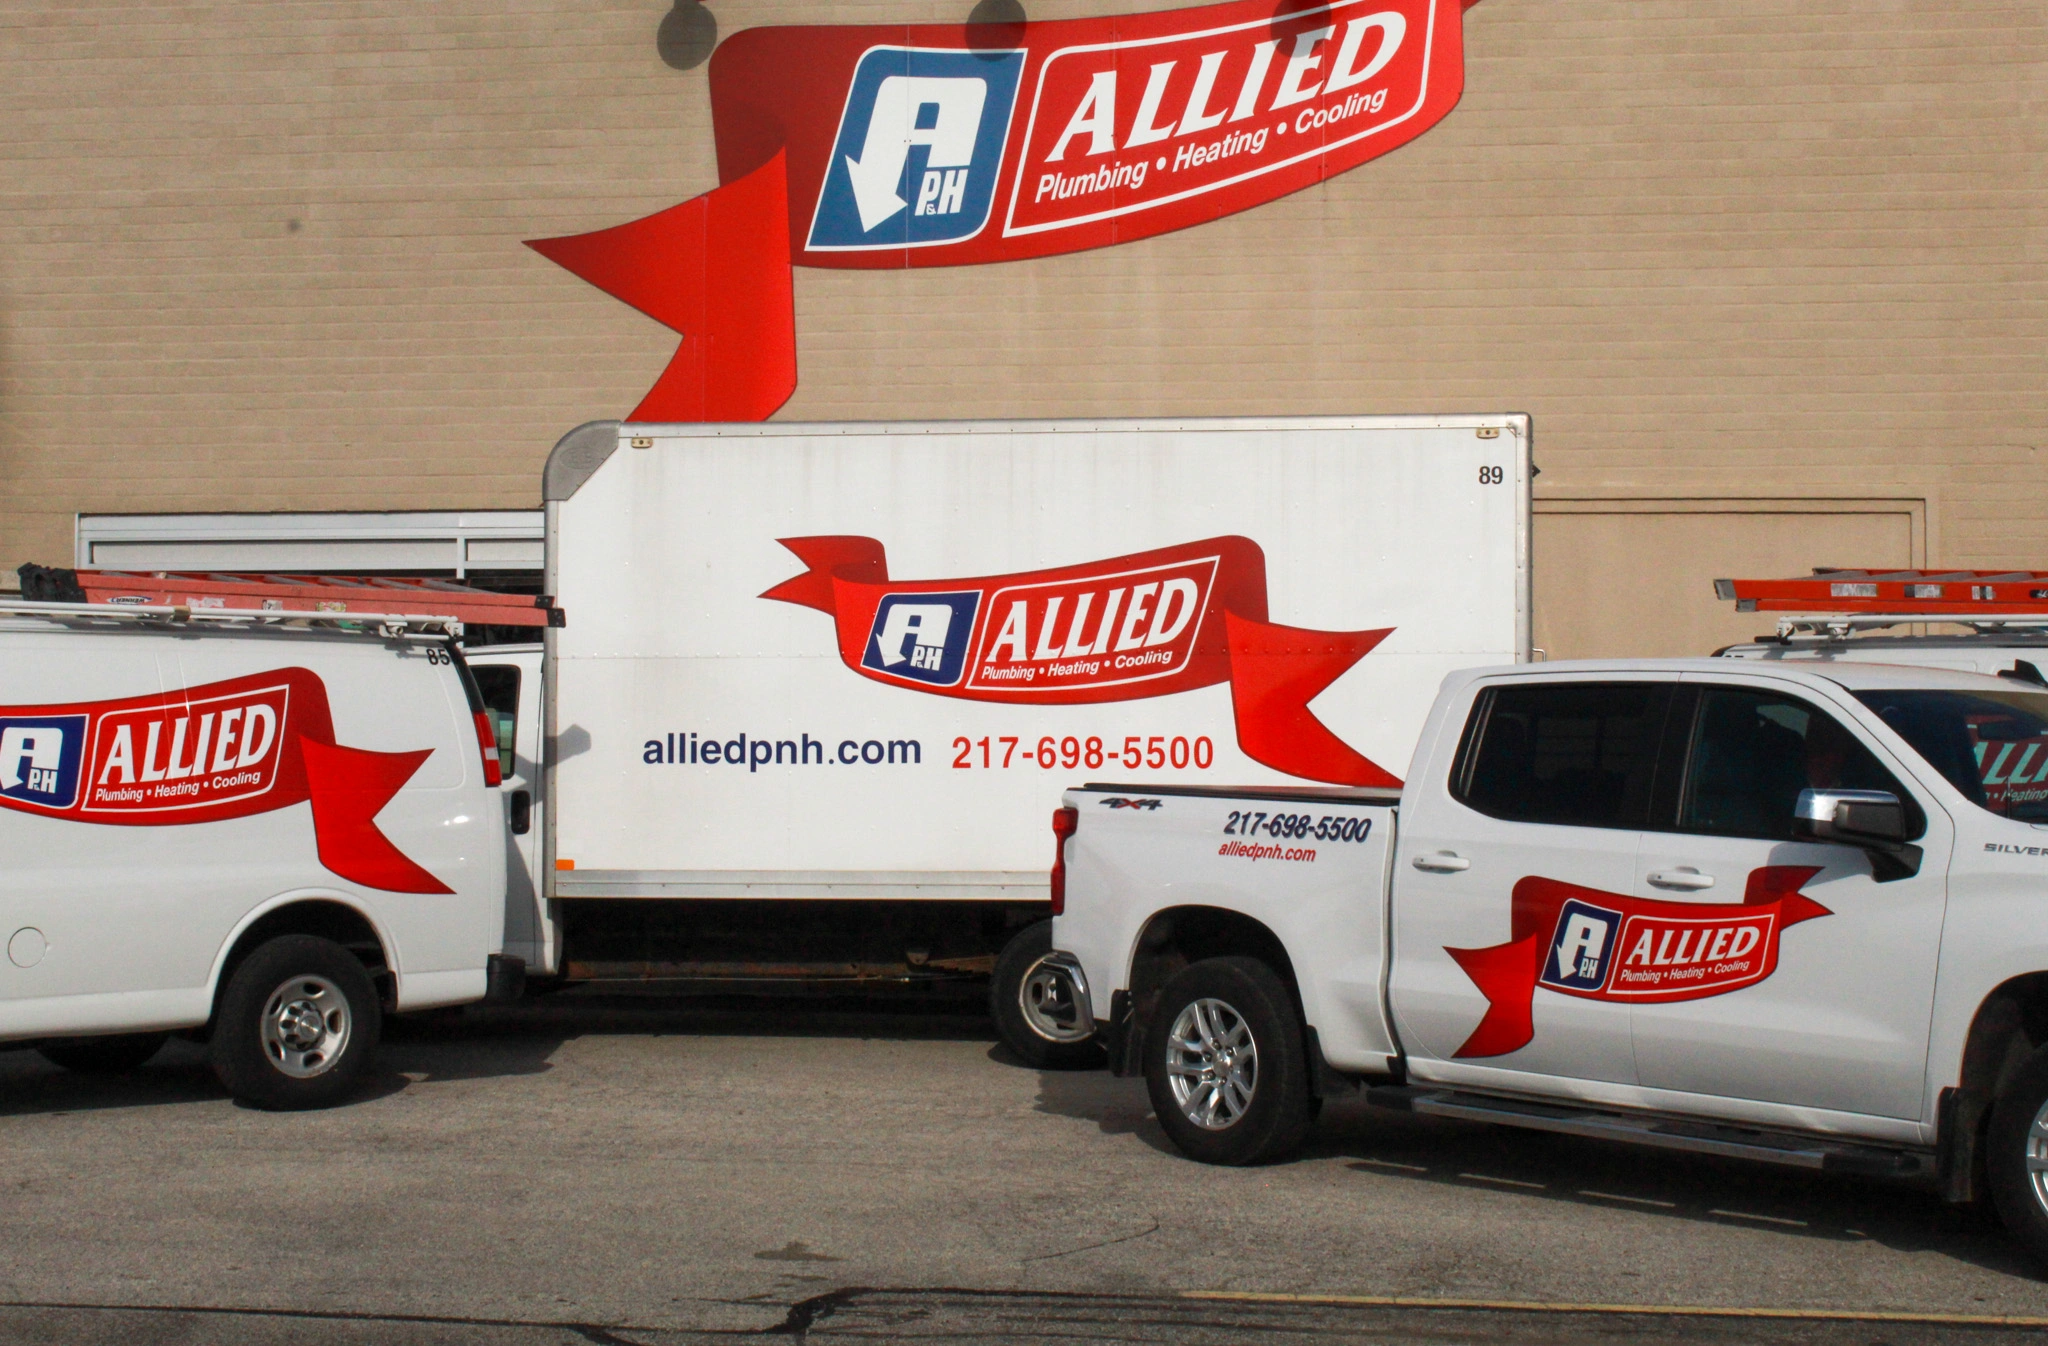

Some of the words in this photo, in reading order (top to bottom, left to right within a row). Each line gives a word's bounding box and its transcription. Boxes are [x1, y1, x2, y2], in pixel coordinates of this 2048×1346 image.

[1044, 11, 1407, 163] ALLIED
[1035, 160, 1148, 203] Plumbing
[1172, 127, 1269, 173] Heating
[1295, 88, 1388, 134] Cooling
[1478, 466, 1504, 485] 89
[985, 577, 1198, 663] ALLIED
[426, 648, 450, 665] 85
[981, 666, 1035, 681] Plumbing
[1048, 661, 1100, 677] Heating
[1115, 651, 1173, 669] Cooling
[97, 704, 276, 785] ALLIED
[642, 733, 922, 772] alliedpnh.com
[952, 736, 1215, 770] 217-698-5500
[96, 788, 143, 803] Plumbing
[154, 781, 200, 798] Heating
[212, 772, 261, 789] Cooling
[1224, 811, 1372, 843] 217-698-5500
[1218, 842, 1316, 862] alliedpnh.com
[1625, 926, 1760, 966] ALLIED
[1620, 969, 1661, 984] Plumbing
[1669, 966, 1704, 980] Heating
[1714, 960, 1750, 974] Cooling
